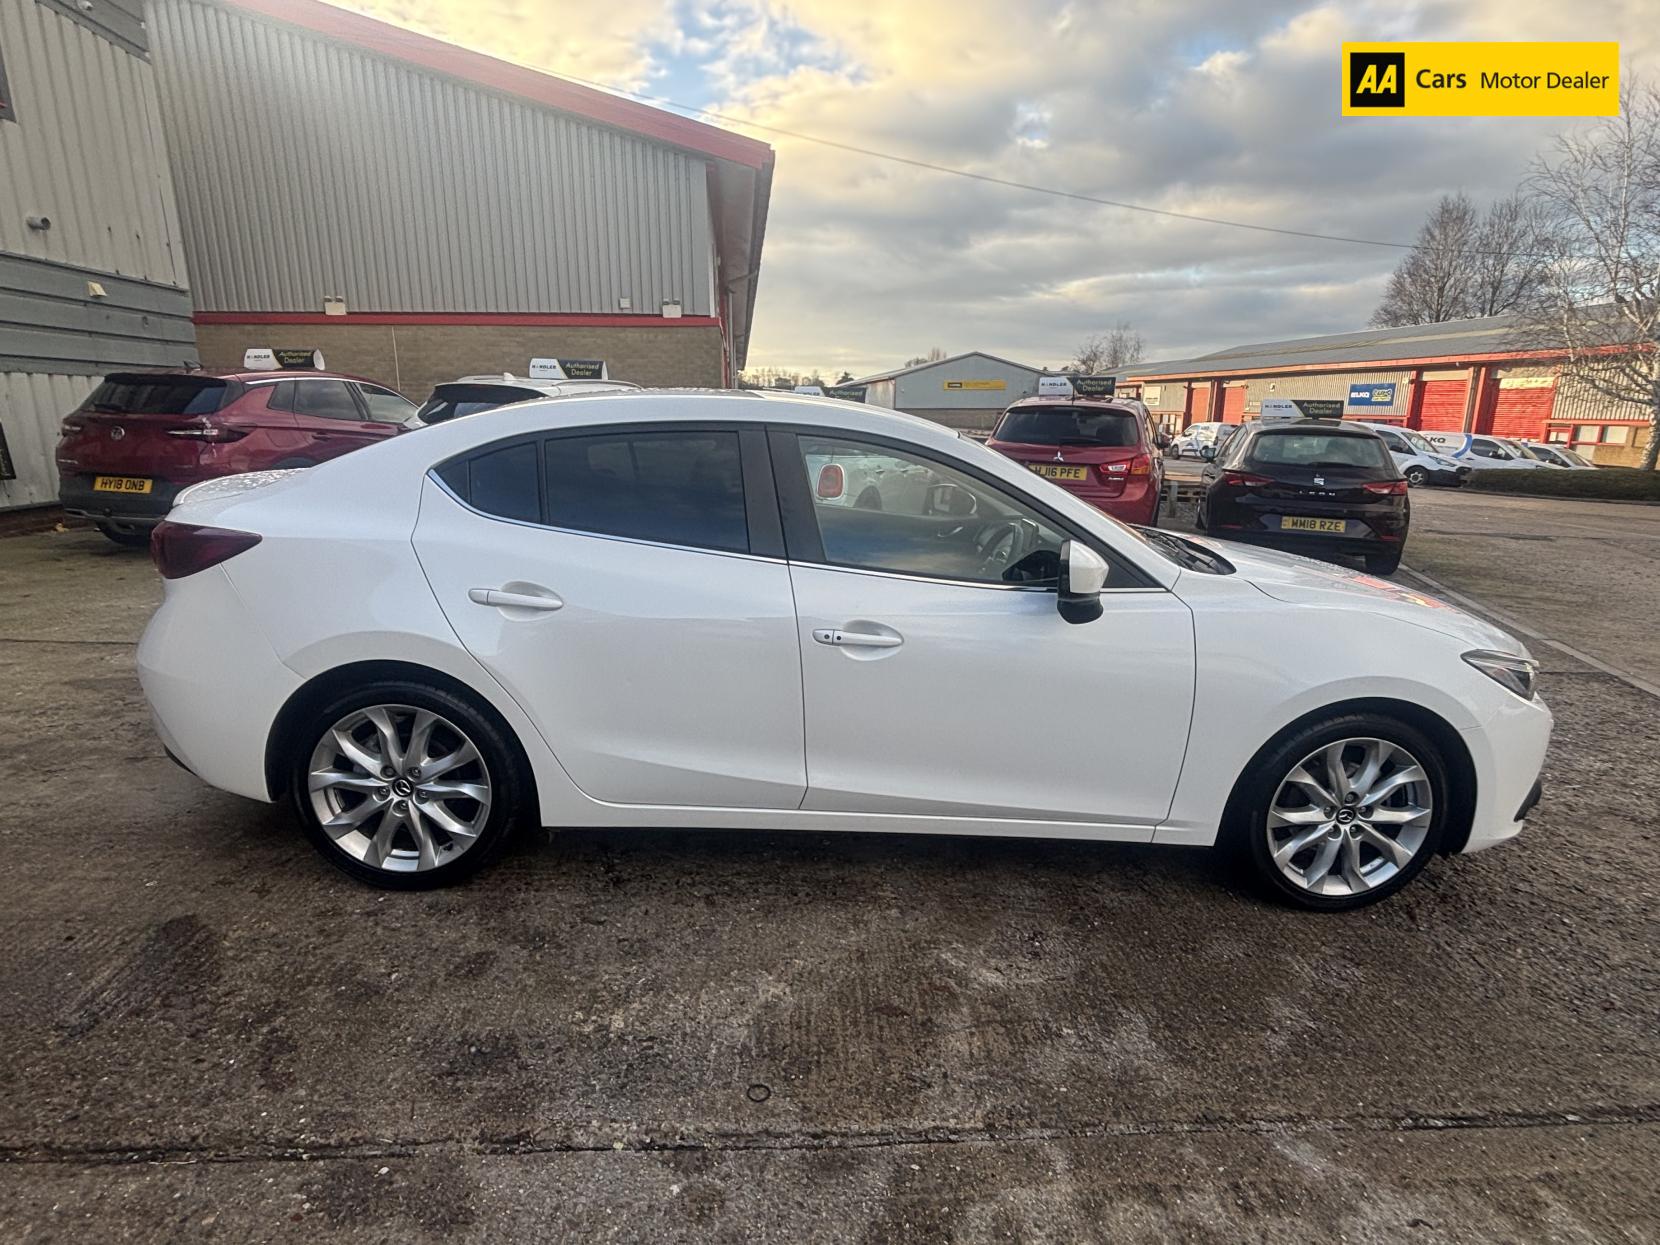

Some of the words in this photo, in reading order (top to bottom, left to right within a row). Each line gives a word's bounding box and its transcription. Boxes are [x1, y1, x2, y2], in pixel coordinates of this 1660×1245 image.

[565, 362, 600, 370] Authorised
[1077, 378, 1112, 386] Authorised
[1303, 401, 1341, 409] Authorised
[1059, 468, 1081, 478] PFE
[100, 477, 124, 490] HY18
[1319, 520, 1343, 531] RZE
